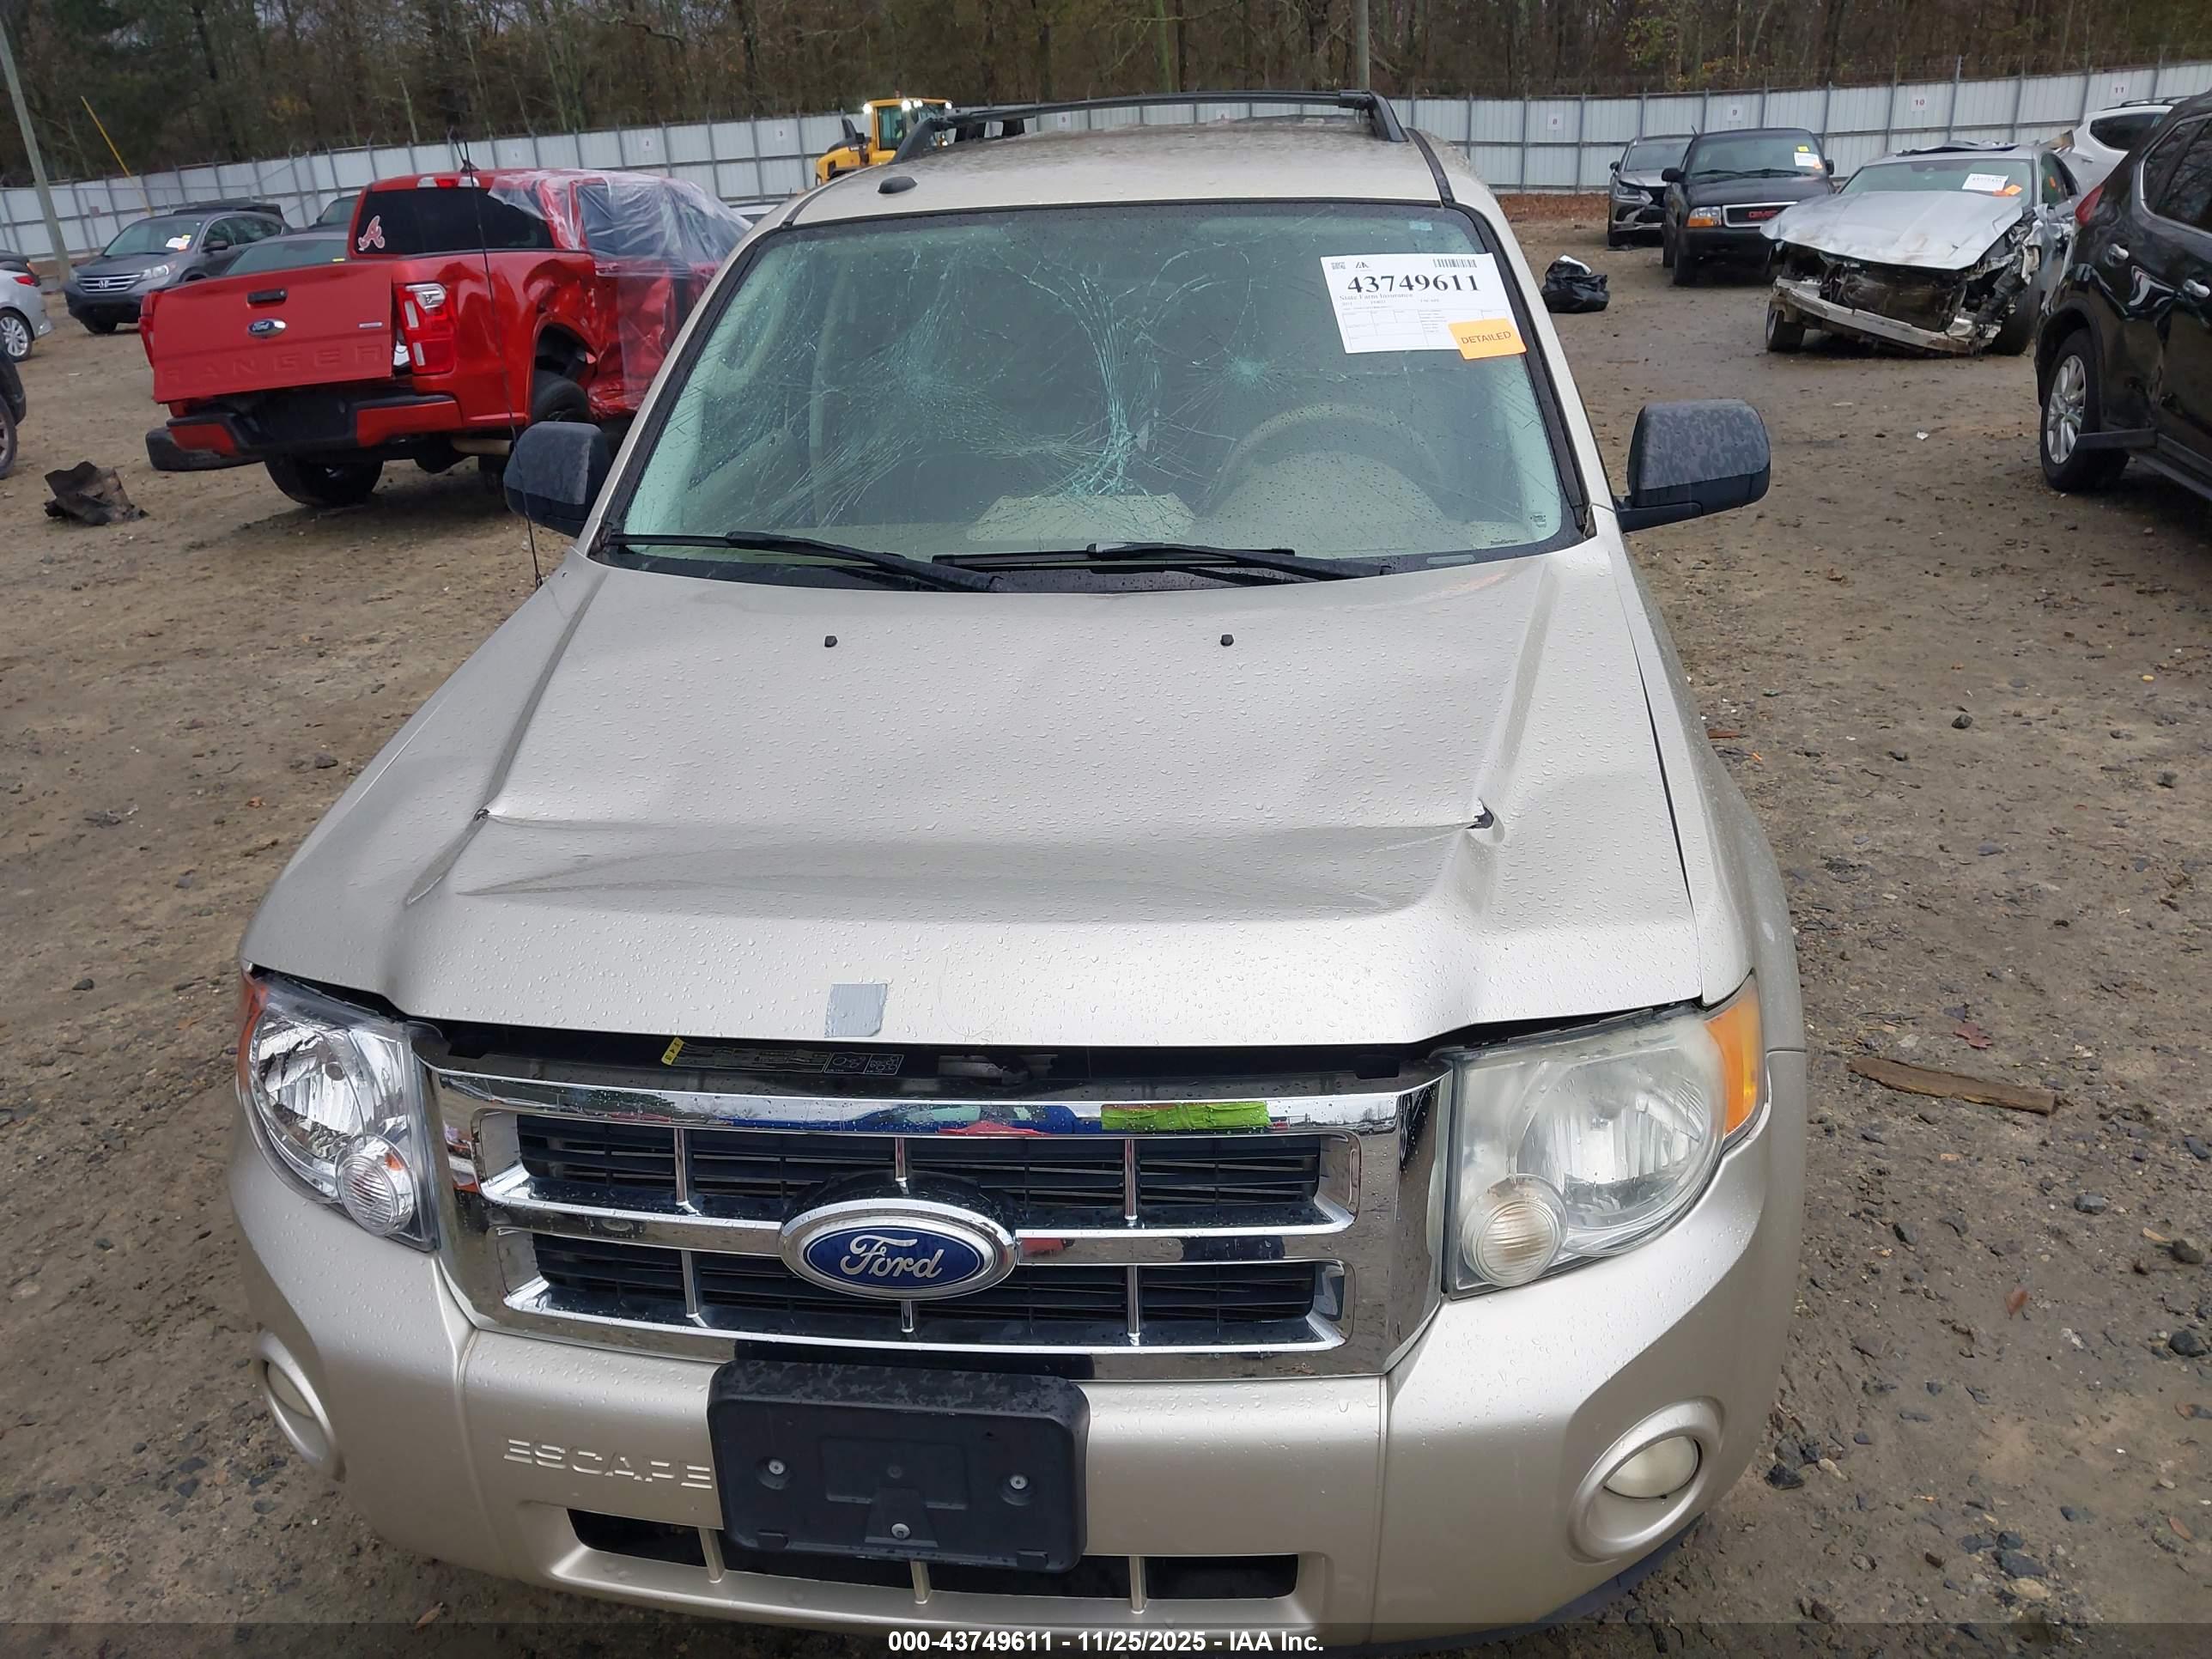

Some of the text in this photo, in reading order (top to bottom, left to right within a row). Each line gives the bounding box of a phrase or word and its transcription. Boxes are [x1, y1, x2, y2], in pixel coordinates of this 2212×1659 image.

[1347, 274, 1481, 294] 43749611
[1461, 331, 1511, 344] DETAILED
[161, 345, 385, 384] RANGER
[840, 1234, 945, 1279] Ford
[504, 1438, 714, 1489] ESCAPE
